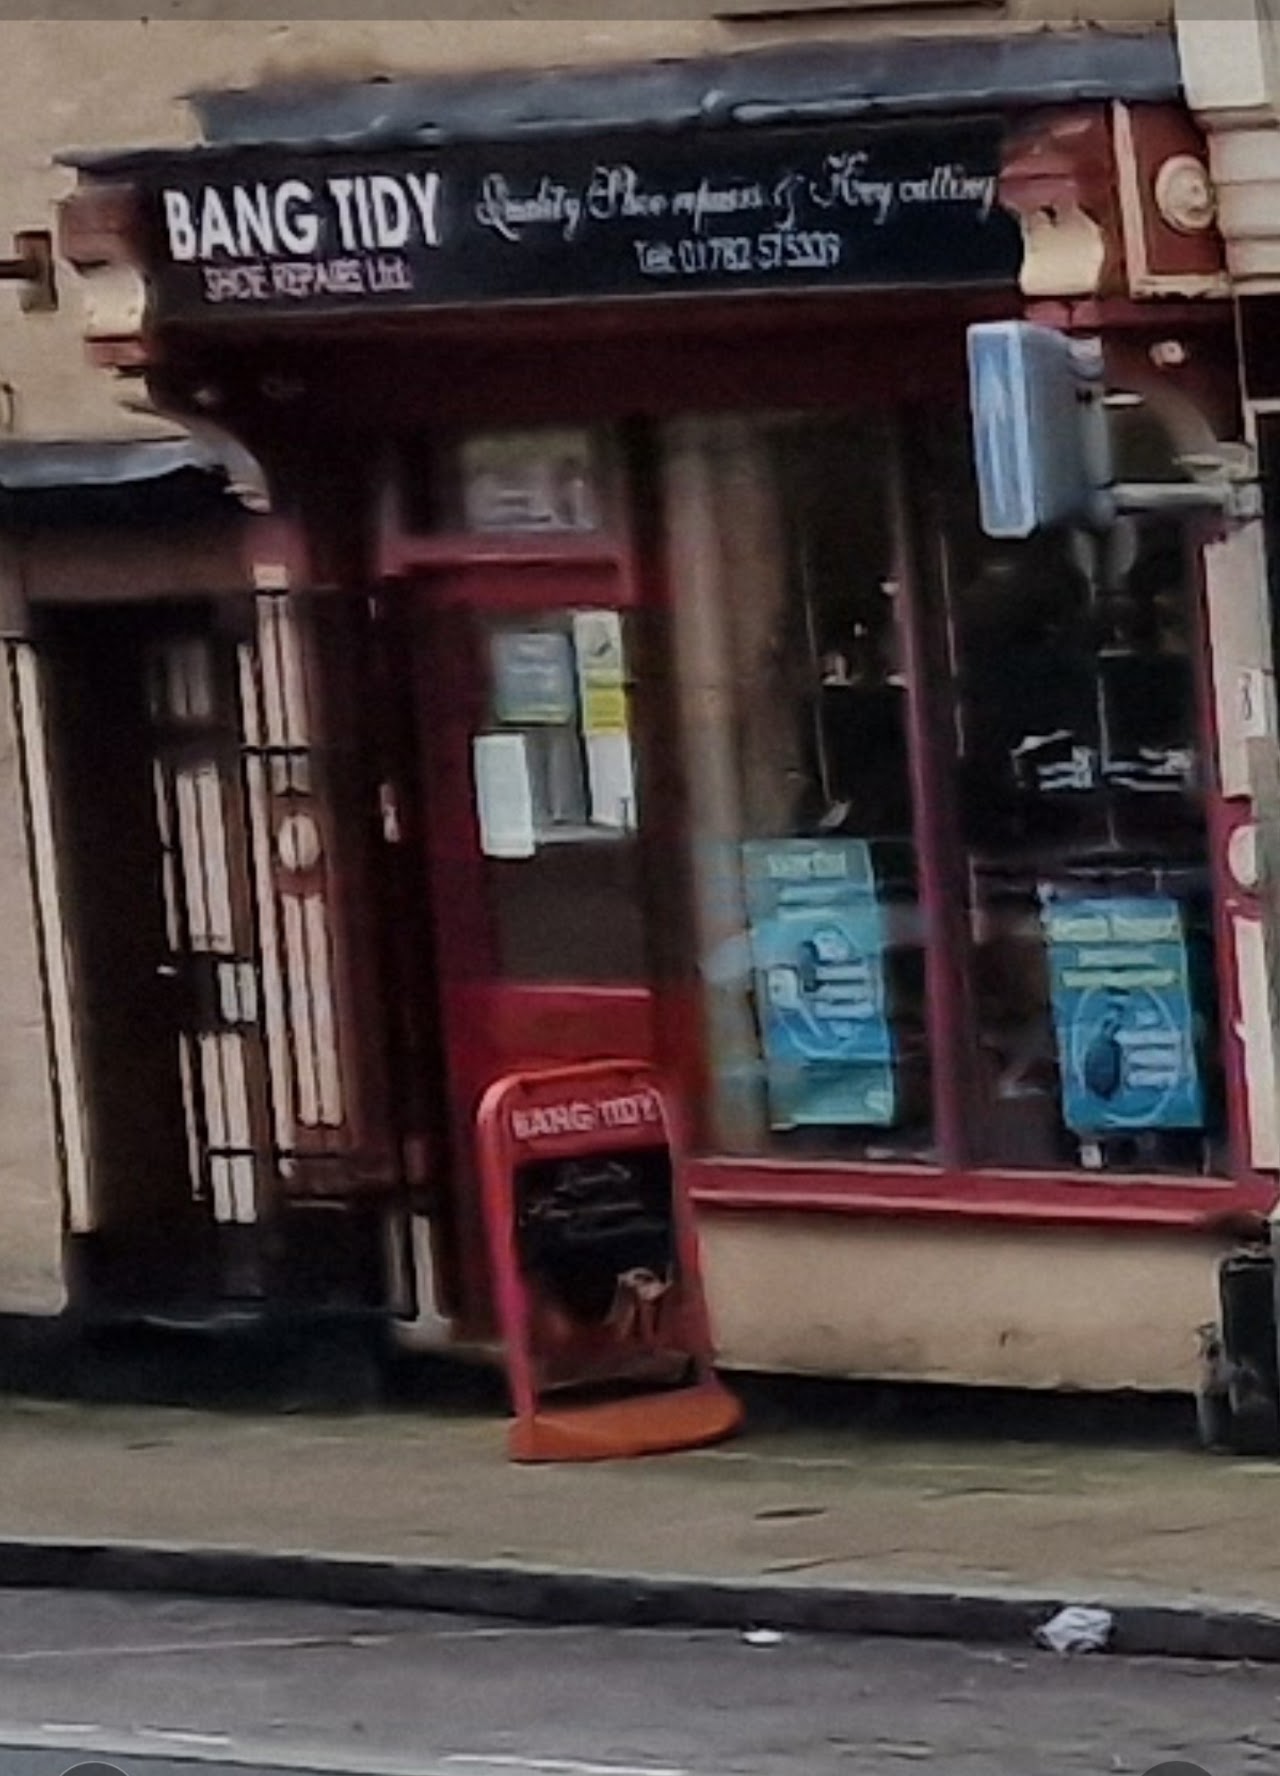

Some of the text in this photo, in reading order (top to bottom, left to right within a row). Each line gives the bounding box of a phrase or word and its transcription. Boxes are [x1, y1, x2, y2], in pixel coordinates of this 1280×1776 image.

[162, 172, 441, 261] BANG TIDY
[475, 172, 580, 241] Quality
[809, 150, 894, 226] Key
[203, 266, 270, 302] SHOE
[271, 259, 365, 297] REPAIRS
[511, 1091, 659, 1140] BANG TIDY
